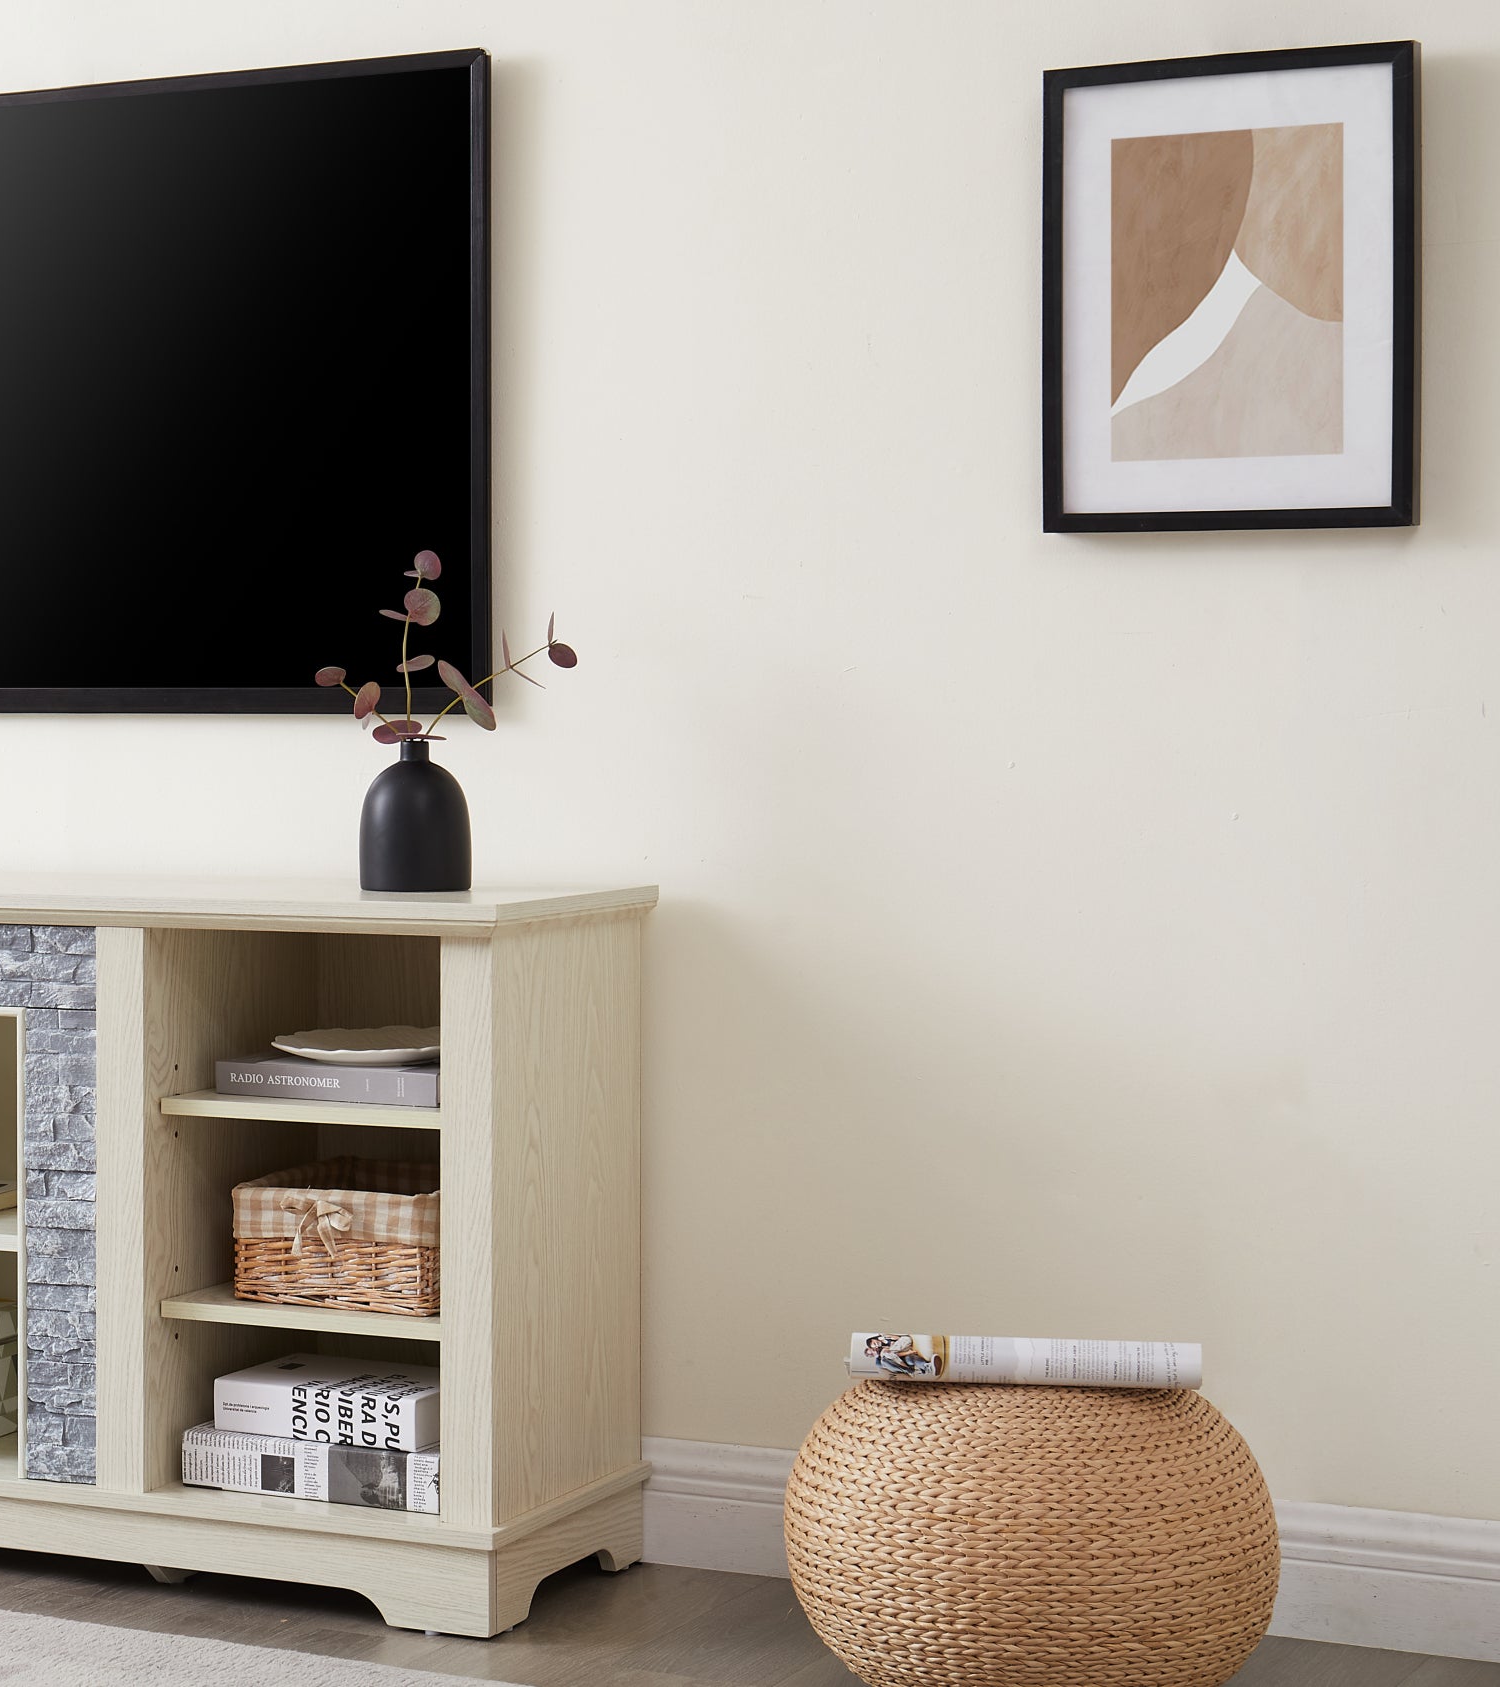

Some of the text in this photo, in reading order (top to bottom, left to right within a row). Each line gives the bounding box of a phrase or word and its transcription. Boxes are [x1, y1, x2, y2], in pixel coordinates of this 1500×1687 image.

[230, 1072, 341, 1089] RADIO ASTRONOMER
[315, 1429, 331, 1443] C
[361, 1431, 377, 1447] D
